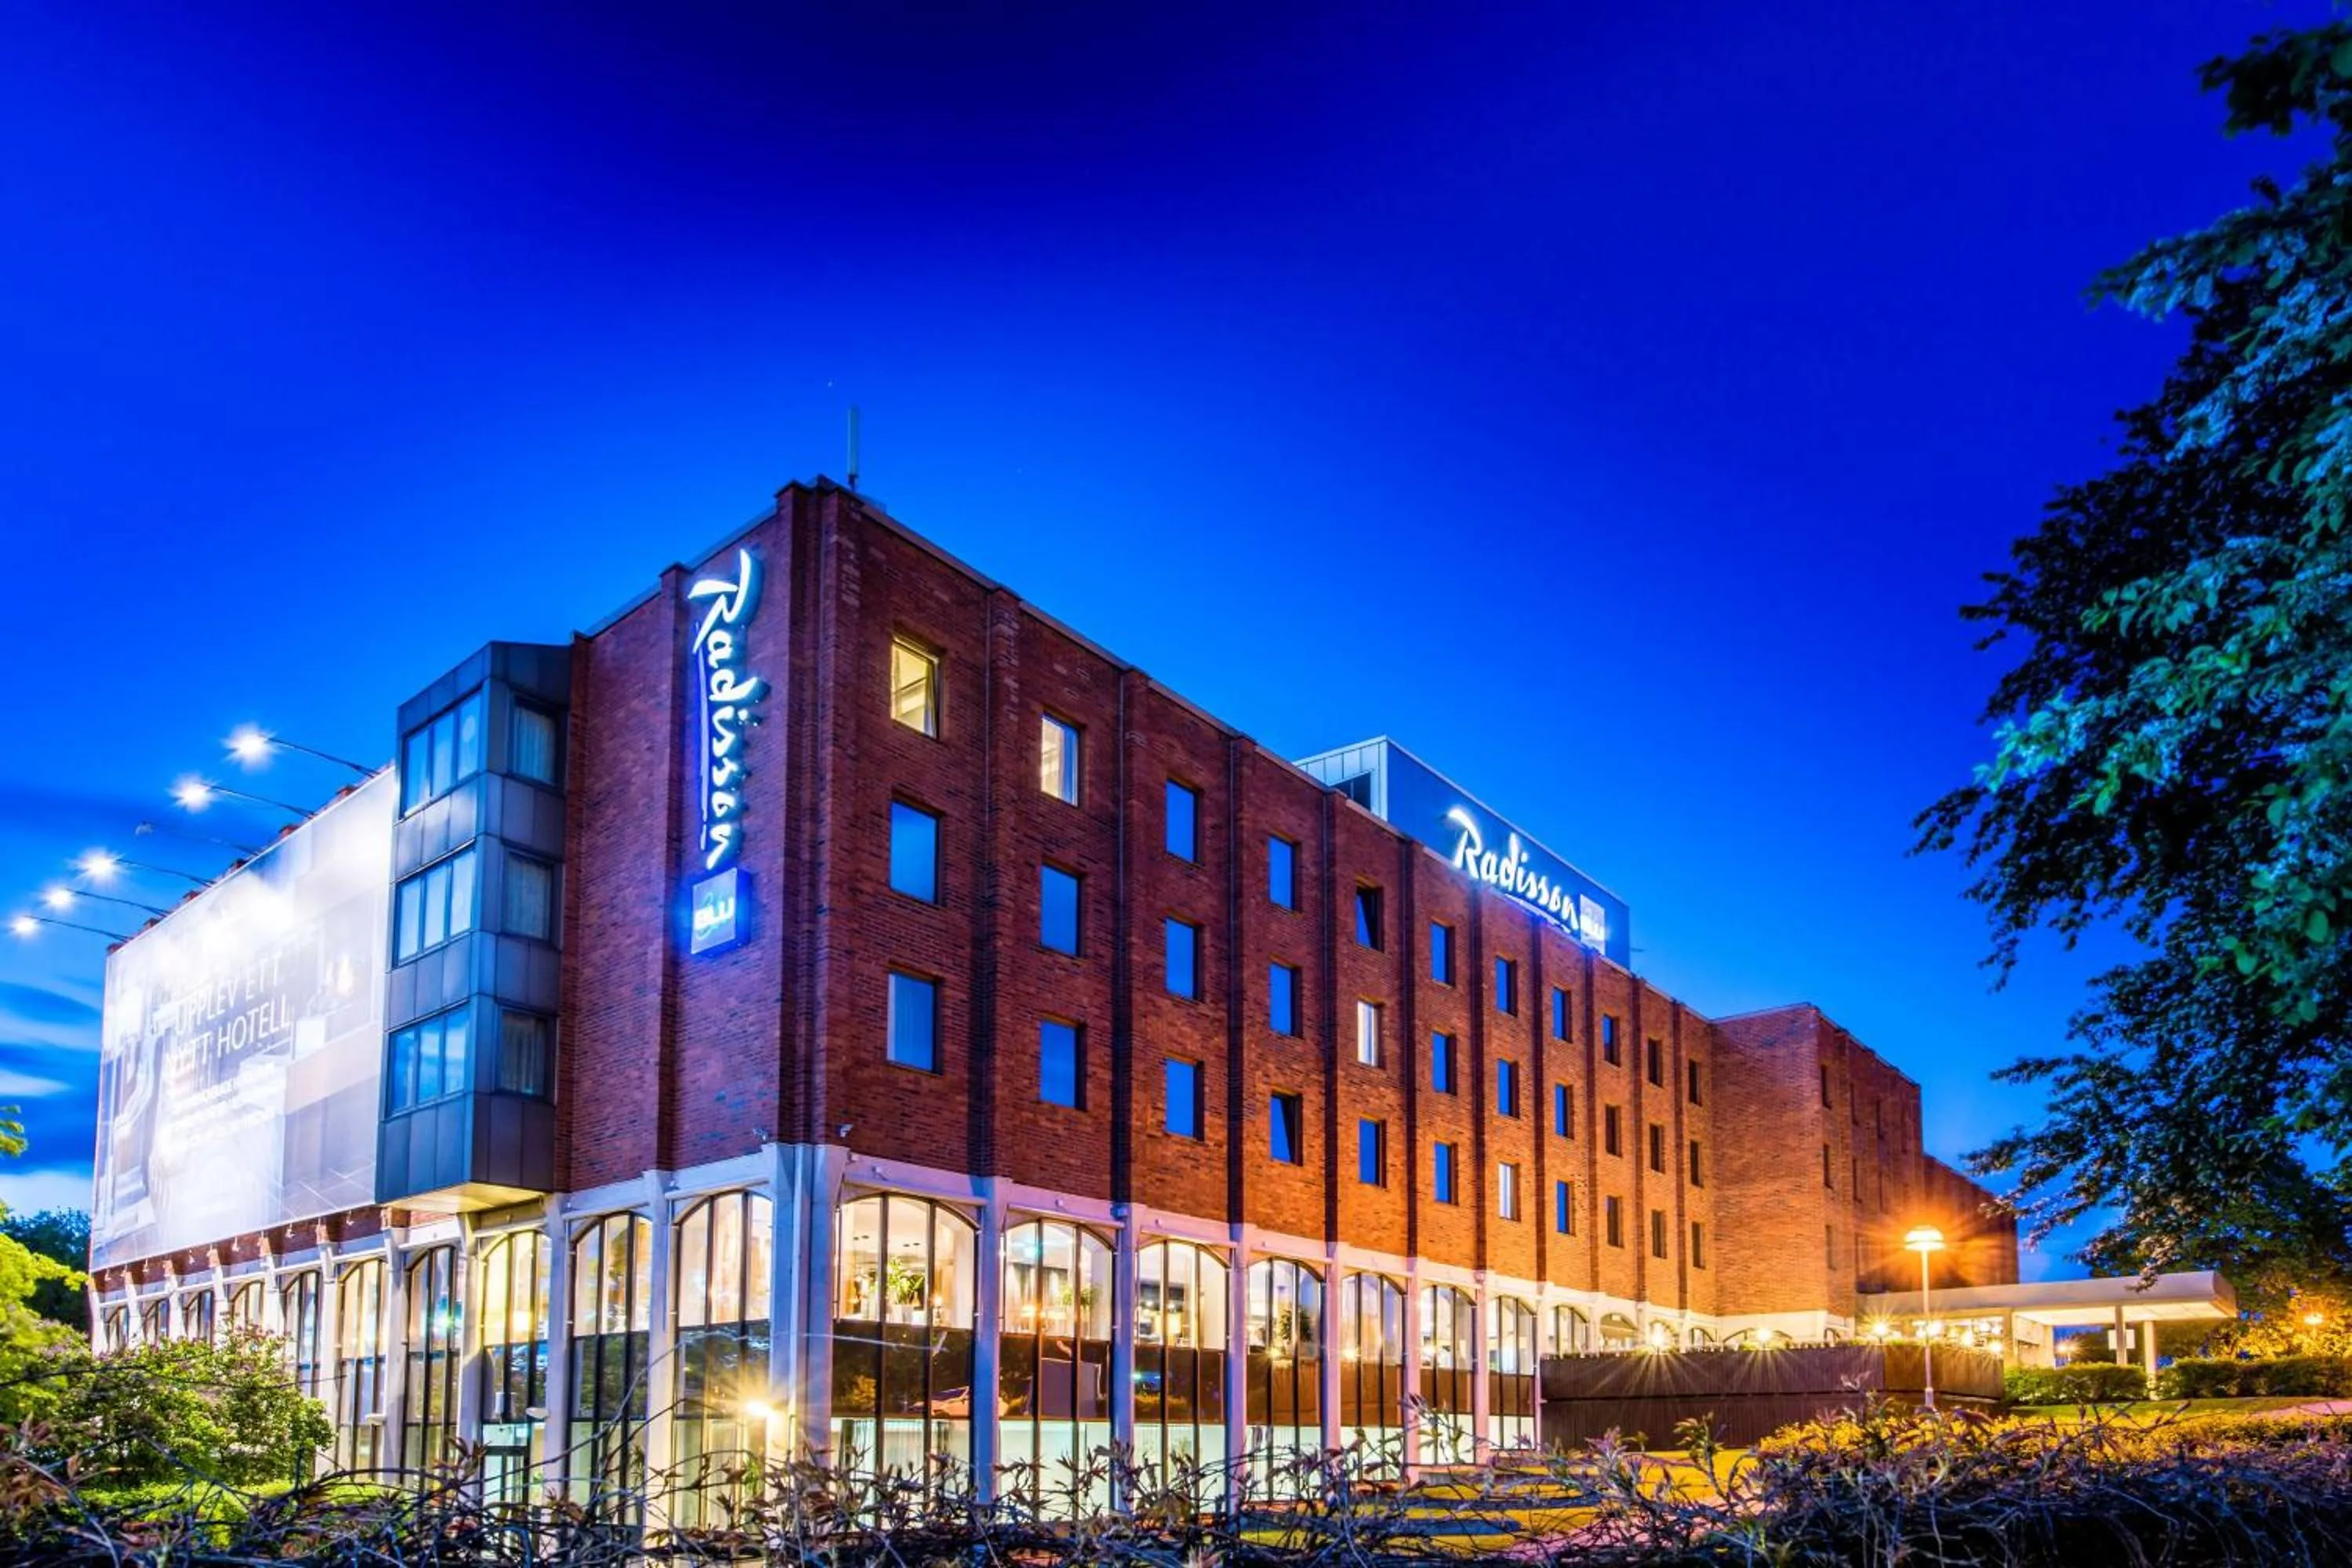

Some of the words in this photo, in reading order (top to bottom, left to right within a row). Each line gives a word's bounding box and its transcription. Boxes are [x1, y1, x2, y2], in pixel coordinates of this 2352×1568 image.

[688, 548, 757, 869] Radisson
[1447, 808, 1579, 930] Radisson
[175, 976, 238, 1036] UPPLEV
[245, 950, 282, 1001] ETT
[217, 994, 290, 1058] HOTELL
